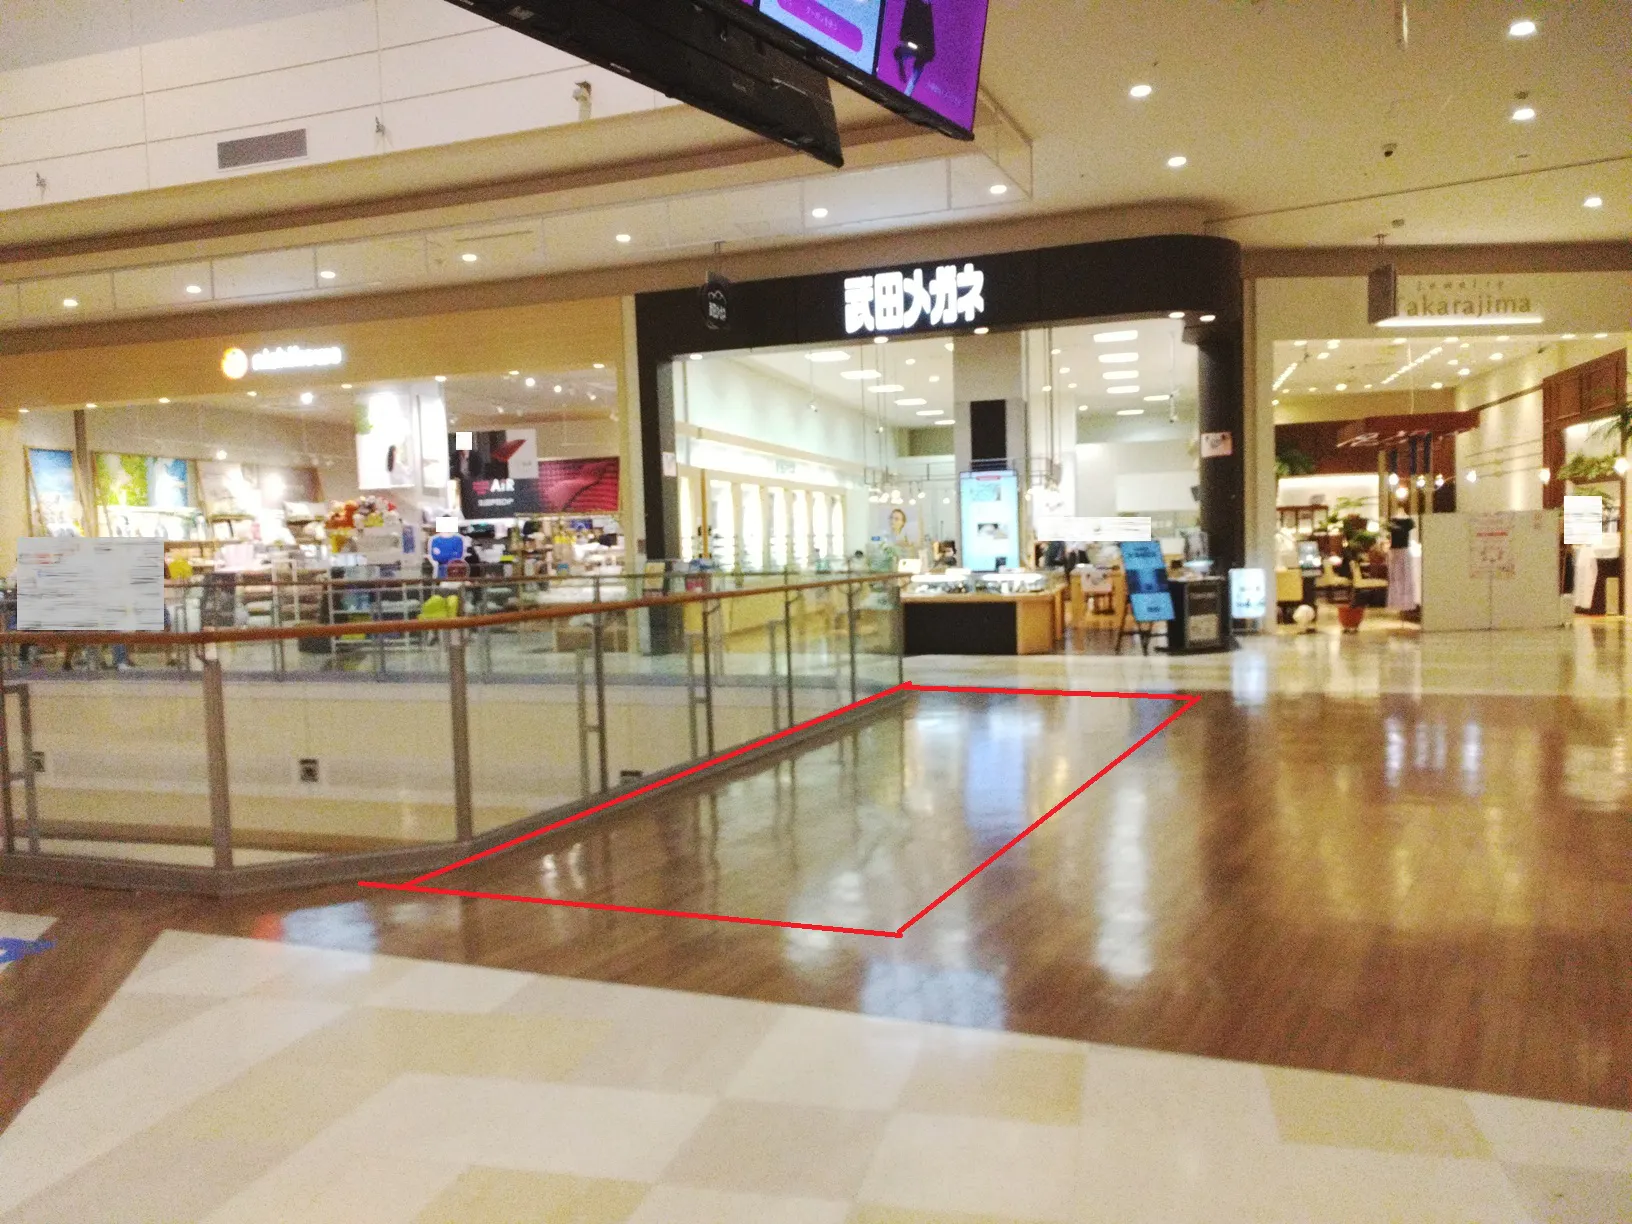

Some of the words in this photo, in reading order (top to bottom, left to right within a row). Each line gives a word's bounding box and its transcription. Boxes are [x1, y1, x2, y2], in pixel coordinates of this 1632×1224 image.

[844, 263, 984, 333] 武田メガネ
[1400, 294, 1531, 317] akarajima
